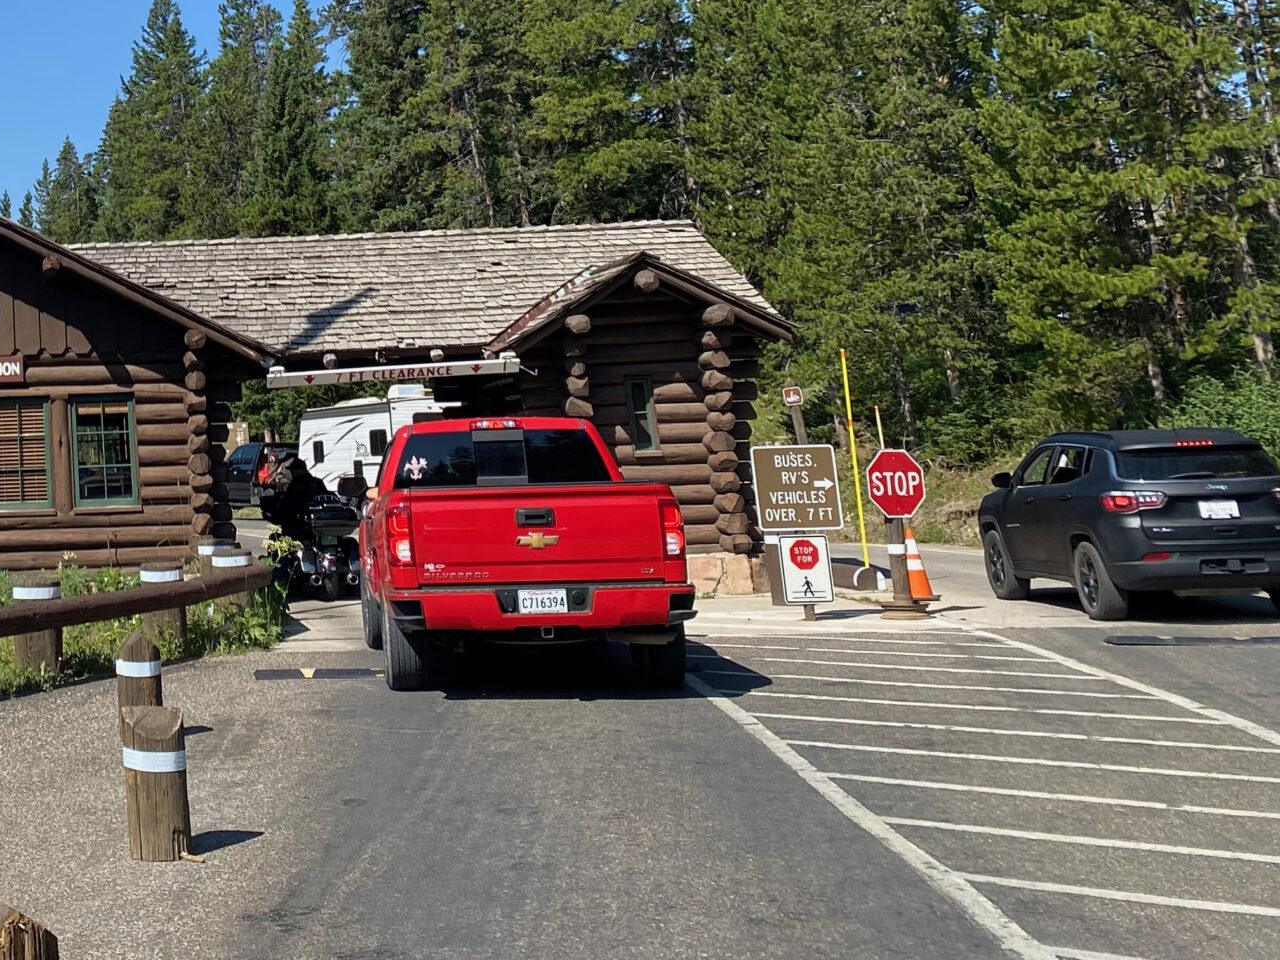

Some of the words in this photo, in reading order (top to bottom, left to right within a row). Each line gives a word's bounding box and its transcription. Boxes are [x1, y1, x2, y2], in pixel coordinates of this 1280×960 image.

[336, 373, 342, 383] 7
[349, 371, 365, 382] FT
[373, 366, 452, 380] CLEARANCE
[782, 471, 809, 485] RV'S
[871, 471, 920, 496] STOP
[770, 491, 826, 505] VEHICLES
[765, 509, 796, 522] OVER
[806, 508, 813, 521] 7
[819, 507, 833, 520] FT
[794, 546, 814, 555] STOP
[797, 555, 812, 563] FOR
[522, 596, 565, 609] C716394
